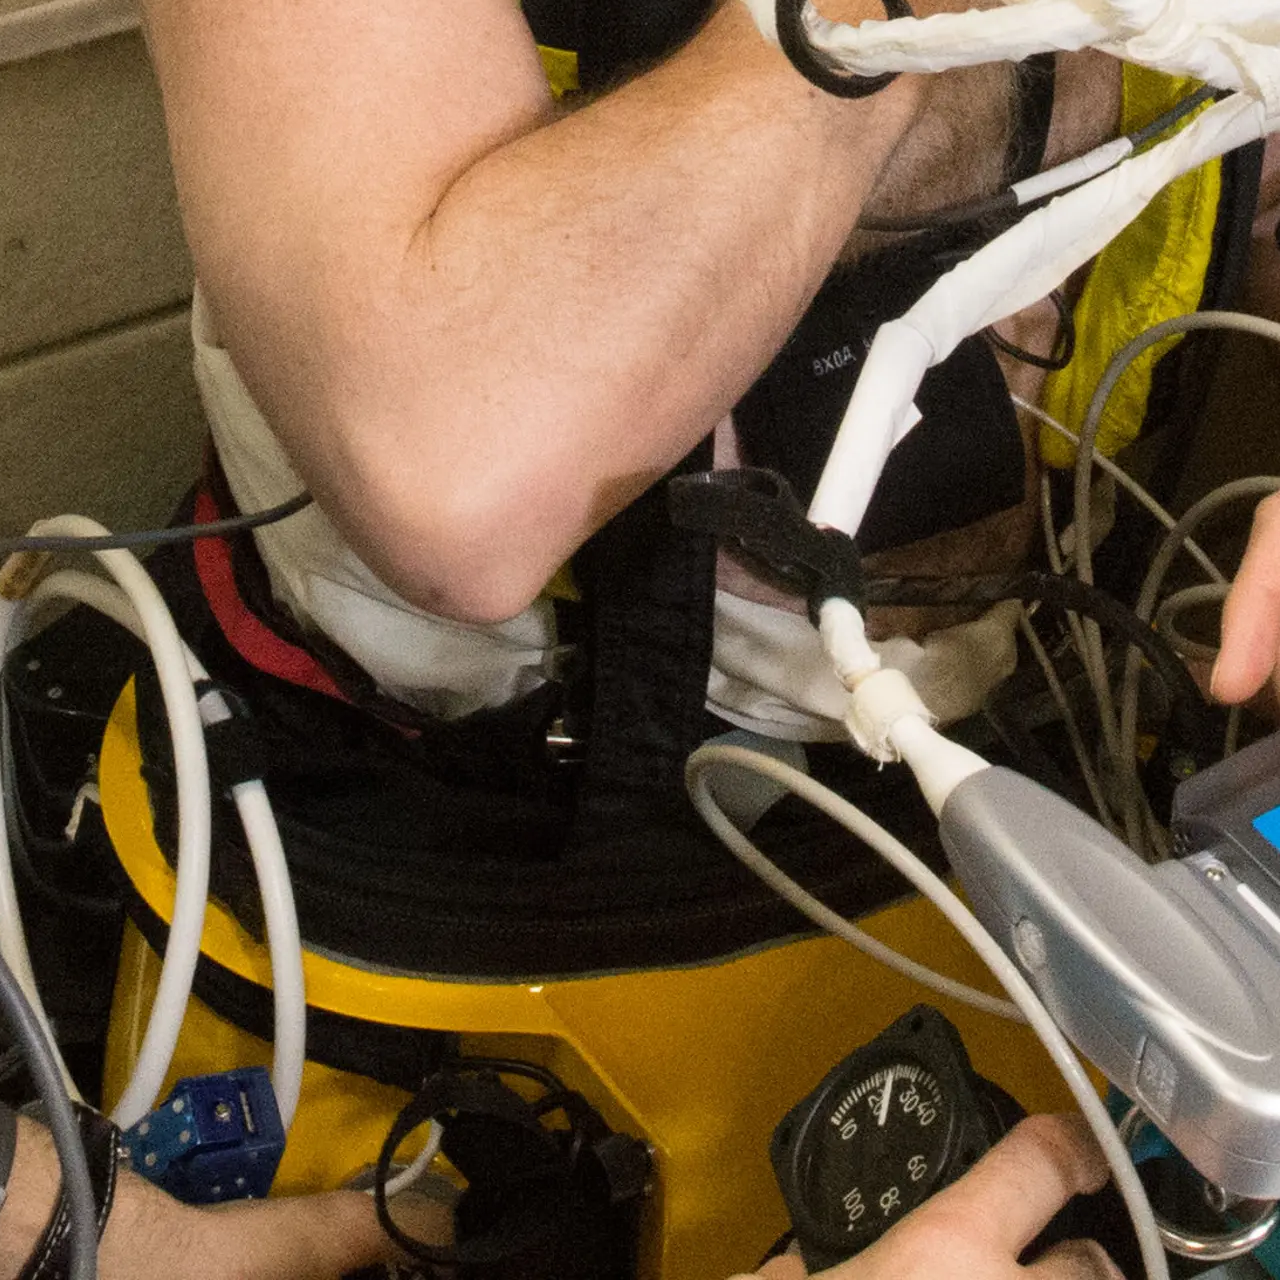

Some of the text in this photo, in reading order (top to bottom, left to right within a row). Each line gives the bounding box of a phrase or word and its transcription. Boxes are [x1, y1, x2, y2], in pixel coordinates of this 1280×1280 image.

[898, 1088, 920, 1113] 30
[915, 1101, 937, 1127] 40
[839, 1117, 859, 1141] 10
[906, 1154, 929, 1184] 60
[842, 1187, 866, 1224] 100
[878, 1185, 902, 1217] 80
